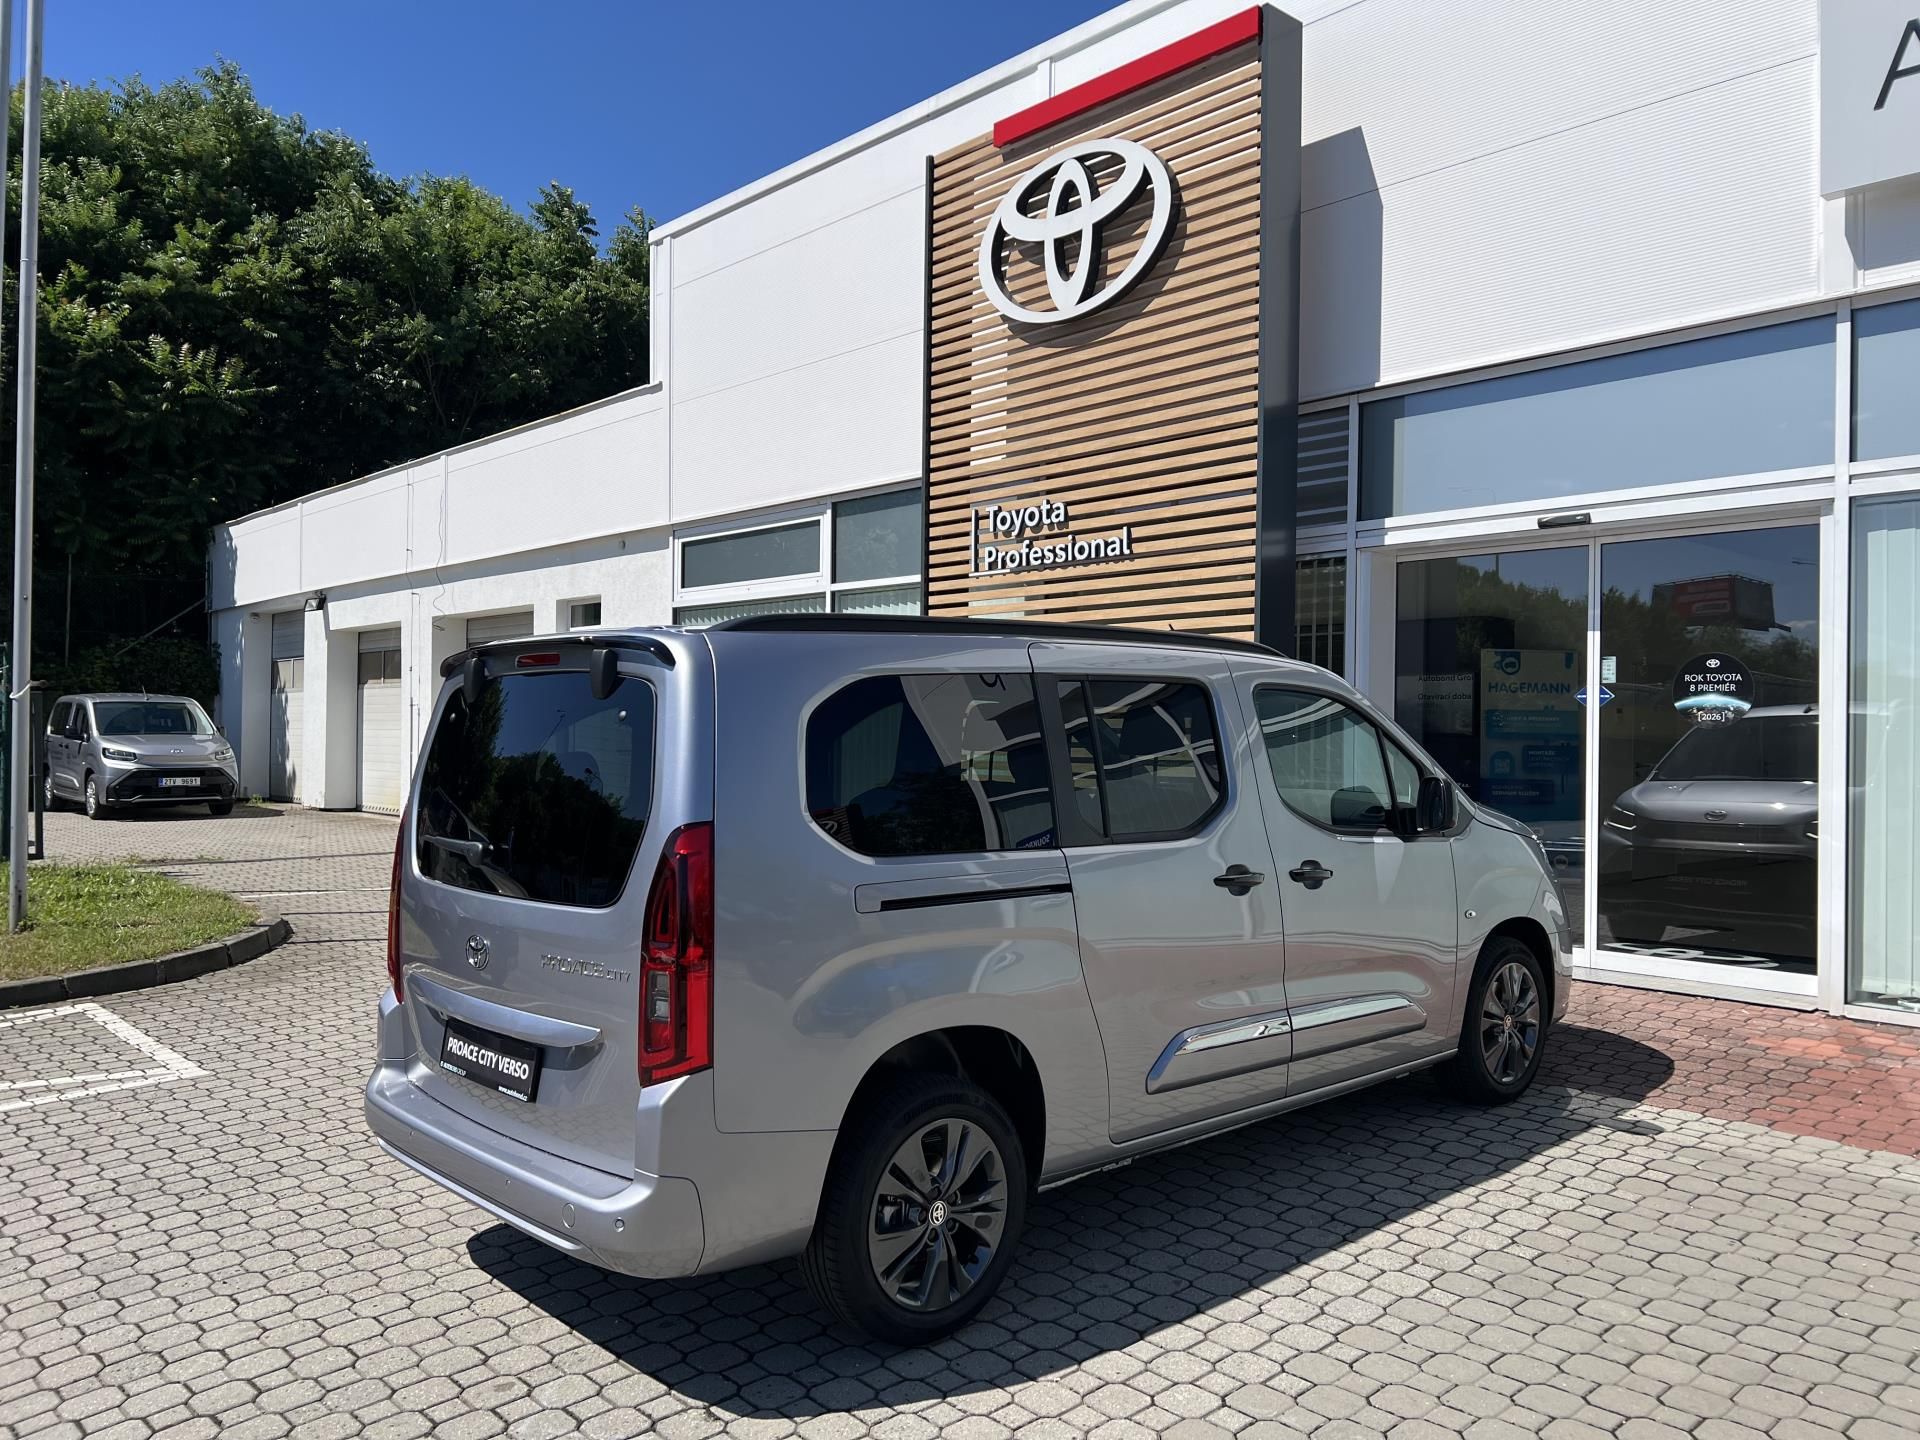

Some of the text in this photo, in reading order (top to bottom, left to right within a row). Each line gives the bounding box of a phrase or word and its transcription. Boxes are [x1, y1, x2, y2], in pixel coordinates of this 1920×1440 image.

[985, 499, 1066, 536] Toyota
[984, 526, 1130, 571] Professional
[1488, 681, 1571, 693] HAGEMANN
[1684, 673, 1742, 682] ROK TOYOTA
[1689, 682, 1736, 692] 8 PREMIÉR
[540, 953, 632, 983] PROACE CITY
[447, 1036, 479, 1062] PROACE
[478, 1048, 499, 1069] CITY
[498, 1055, 529, 1080] VERSO
